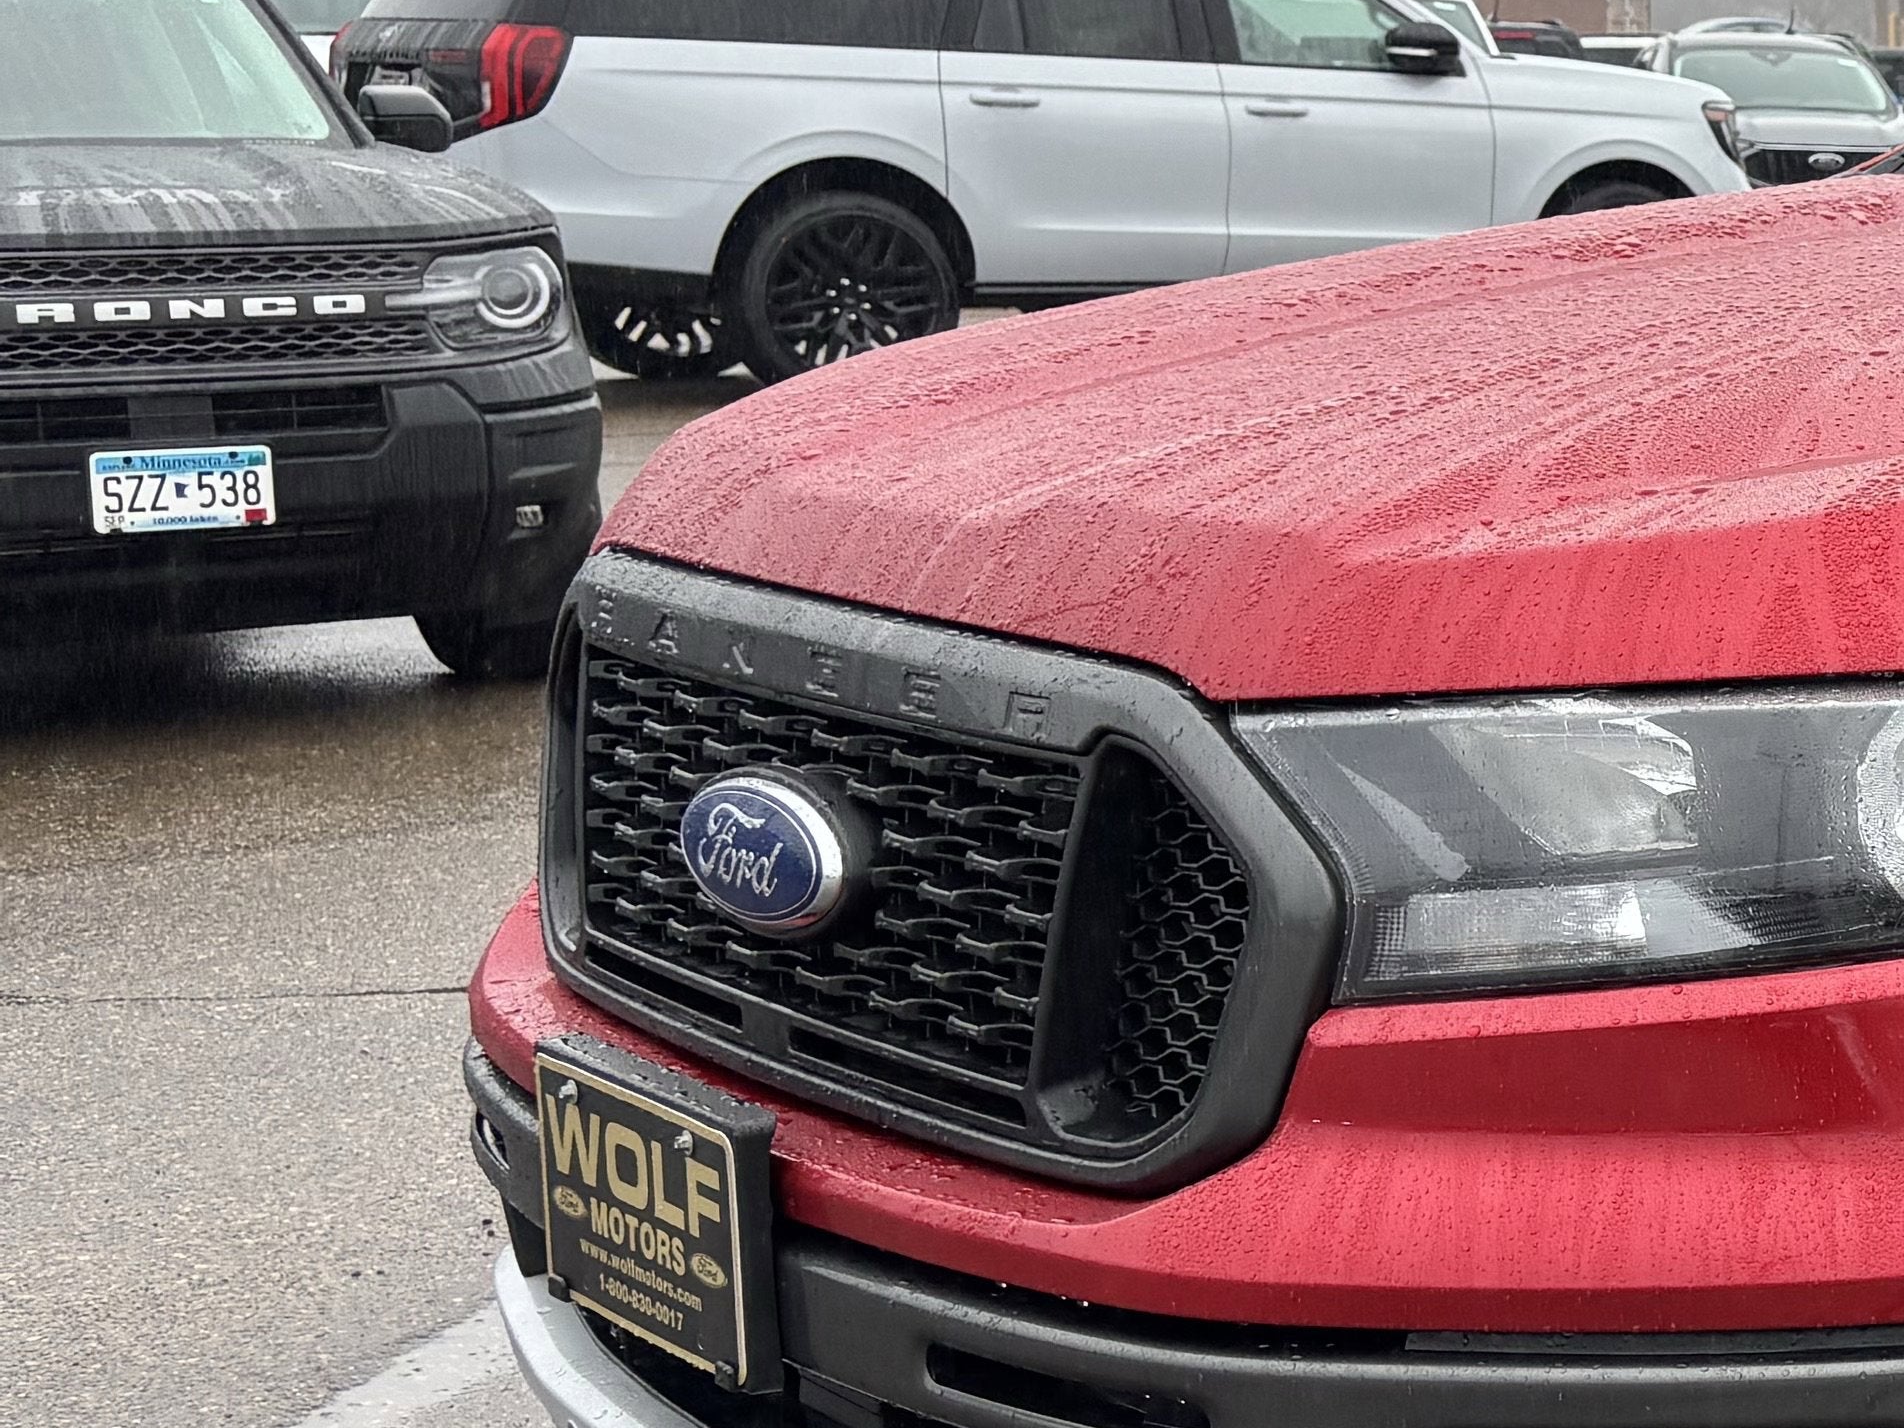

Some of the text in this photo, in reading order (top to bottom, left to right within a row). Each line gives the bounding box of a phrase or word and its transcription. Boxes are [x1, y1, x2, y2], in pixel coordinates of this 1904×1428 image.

[103, 470, 262, 514] SZZ 538
[140, 456, 222, 470] Minnesota
[698, 802, 784, 897] Ford
[545, 1094, 721, 1238] WOLF
[590, 1197, 687, 1276] MOTORS
